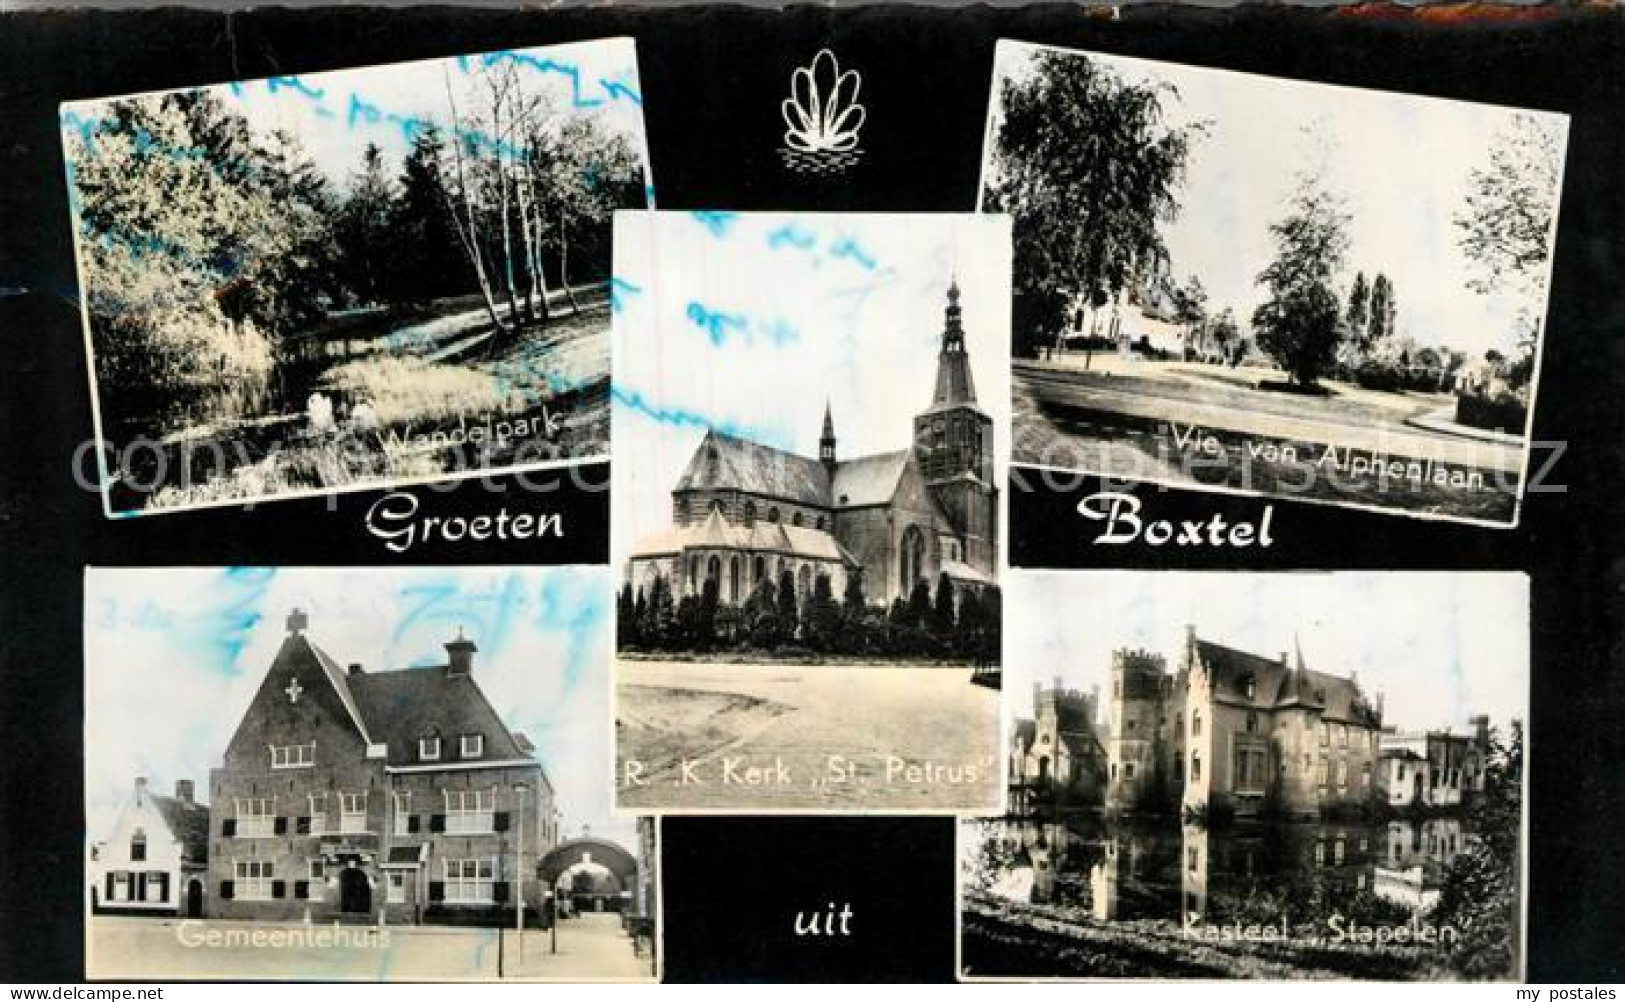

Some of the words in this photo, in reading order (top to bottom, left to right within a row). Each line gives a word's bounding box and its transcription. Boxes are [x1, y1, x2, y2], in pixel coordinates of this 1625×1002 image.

[375, 404, 563, 453] Wandelpark
[1247, 439, 1297, 464] van
[365, 492, 565, 552] Groeten
[1076, 491, 1274, 547] Boxtel
[722, 756, 792, 785] Kerk
[176, 918, 392, 949] Gemeentehuis
[793, 901, 854, 936] uit
[1182, 910, 1288, 943] Kasteel
